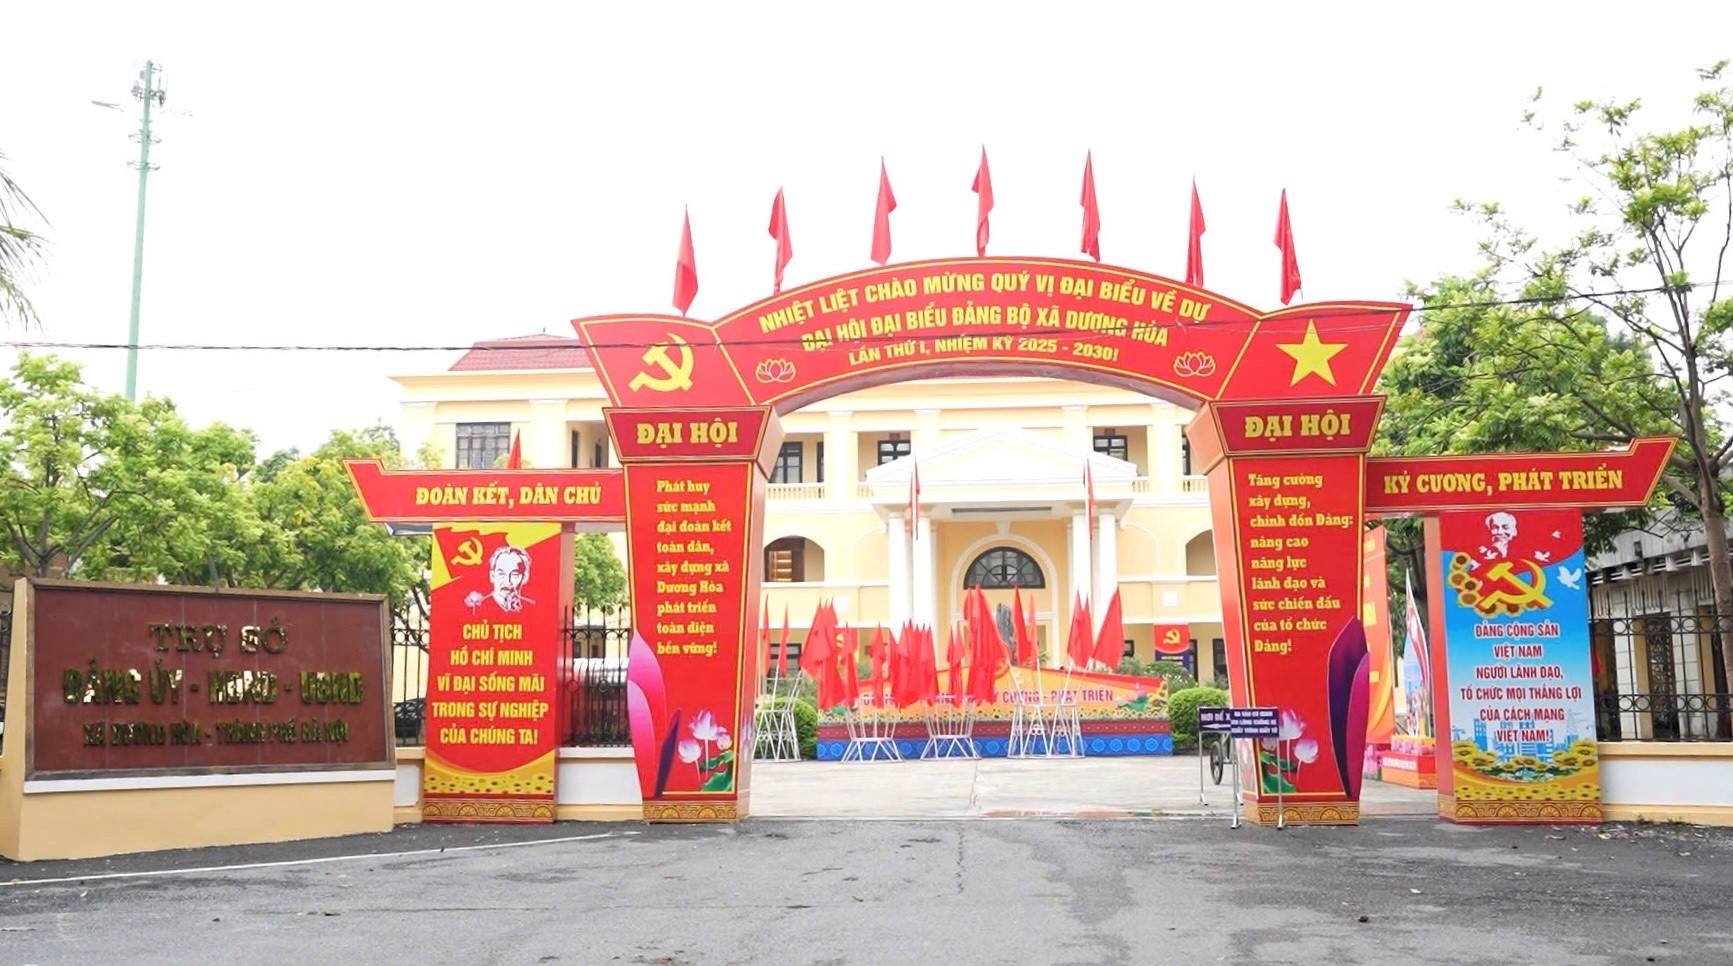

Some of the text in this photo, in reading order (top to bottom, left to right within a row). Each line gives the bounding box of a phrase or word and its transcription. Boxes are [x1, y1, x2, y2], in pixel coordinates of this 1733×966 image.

[759, 270, 1212, 333] NHIỆT LIỆT CHÀO MỪNG QUÝ VỊ ĐẠI BIỂU VỀ DỰ
[801, 300, 1169, 352] ĐẠI HỘI ĐẠI BIỂU ĐẢNG BỘ XÃ DƯƠNG HÒA
[848, 344, 881, 366] LẦN
[886, 338, 917, 359] THỨ
[935, 333, 988, 353] NHIỆM
[992, 334, 1014, 351] KỲ
[1018, 337, 1057, 353] 2025
[1072, 342, 1119, 362] 2030!
[636, 417, 738, 449] ĐẠI HỘI
[1244, 409, 1351, 442] ĐẠI HỘI
[656, 479, 711, 496] Phát huy
[1248, 472, 1323, 489] Tăng cường
[1383, 462, 1623, 497] KỶ CƯƠNG, PHÁT TRIỂN
[415, 480, 602, 509] ĐOÀN KẾT, DÂN CHỦ
[1248, 493, 1312, 511] xây dựng,
[656, 499, 716, 516] sức mạnh
[656, 520, 677, 536] đại
[712, 518, 732, 533] kết
[1288, 512, 1313, 527] đốn
[656, 540, 685, 554] toàn
[1286, 537, 1309, 548] cao
[656, 561, 678, 577] xây
[680, 560, 713, 576] dựng
[1286, 555, 1308, 571] lực
[656, 580, 724, 597] Dương Hòa
[1283, 576, 1308, 592] đạo
[1310, 575, 1327, 589] và
[656, 600, 685, 618] phát
[1252, 594, 1341, 611] sức chiến đấu
[462, 618, 523, 643] CHỦ TỊCH
[656, 620, 714, 637] toàn diện
[1253, 618, 1278, 632] của
[1295, 617, 1328, 631] chức
[1475, 619, 1560, 640] ĐẢNG CỘNG SẢN
[148, 623, 229, 659] TRỤ
[682, 641, 718, 657] vững!
[1254, 638, 1292, 655] Đảng!
[450, 644, 534, 666] HỒ CHÍ MINH
[1494, 643, 1543, 660] VIỆT NAM
[1476, 663, 1508, 679] NGƯỜI
[63, 657, 142, 705] ĐẢNG
[437, 670, 545, 695] VĨ ĐẠI SỐNG MÃI
[1475, 685, 1504, 700] CHỨC
[1506, 687, 1526, 702] MỌI
[1528, 683, 1563, 700] THẮNG
[1565, 686, 1582, 702] LỢI
[431, 699, 549, 721] TRONG SỰ NGHIỆP
[1479, 705, 1565, 724] CỦA CÁCH MẠNG
[440, 722, 539, 744] CỦA CHÚNG TA!
[1496, 726, 1550, 744] VIỆT NAM!
